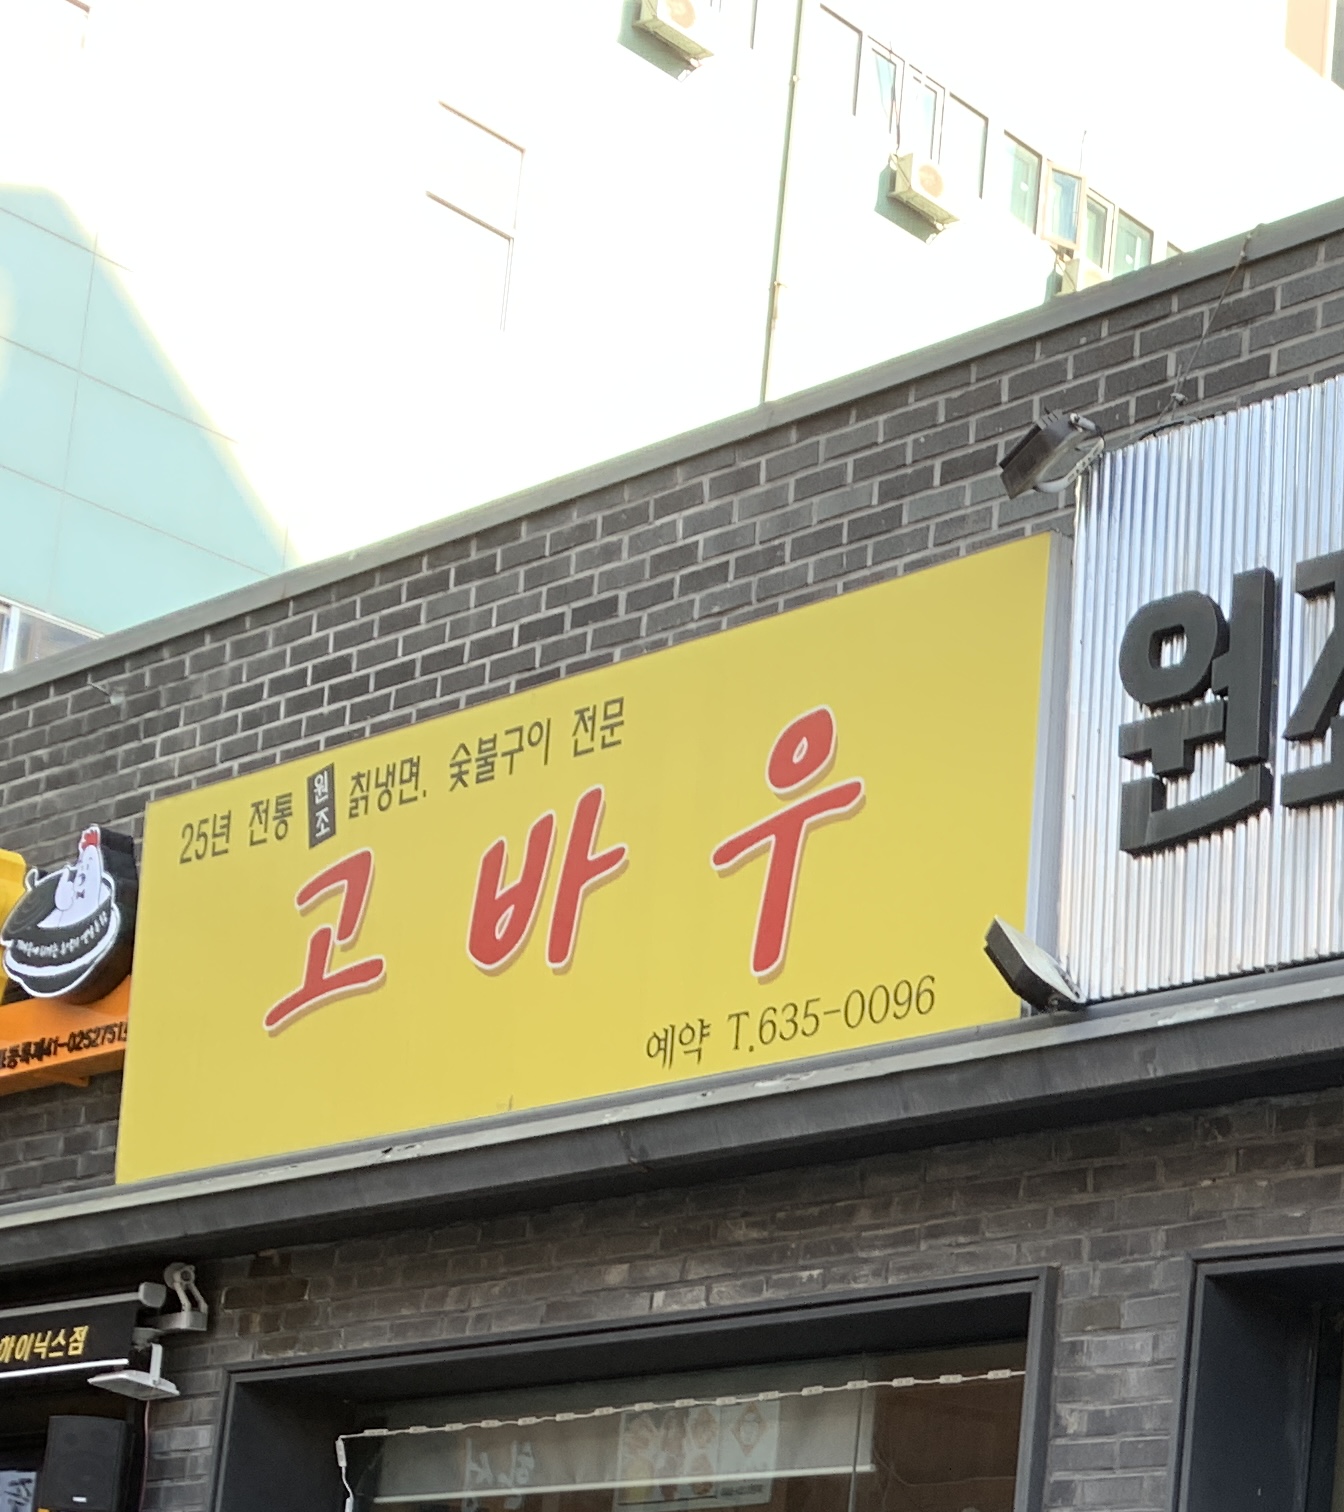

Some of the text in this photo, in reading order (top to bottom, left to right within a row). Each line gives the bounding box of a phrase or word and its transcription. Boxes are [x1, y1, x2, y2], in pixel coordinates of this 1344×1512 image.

[179, 809, 232, 864] 25년
[248, 792, 293, 847] 전통
[313, 771, 332, 839] 원조
[449, 718, 551, 792] 숯불구이
[573, 696, 626, 757] 전문
[644, 975, 938, 1070] 예약 T.635-0096
